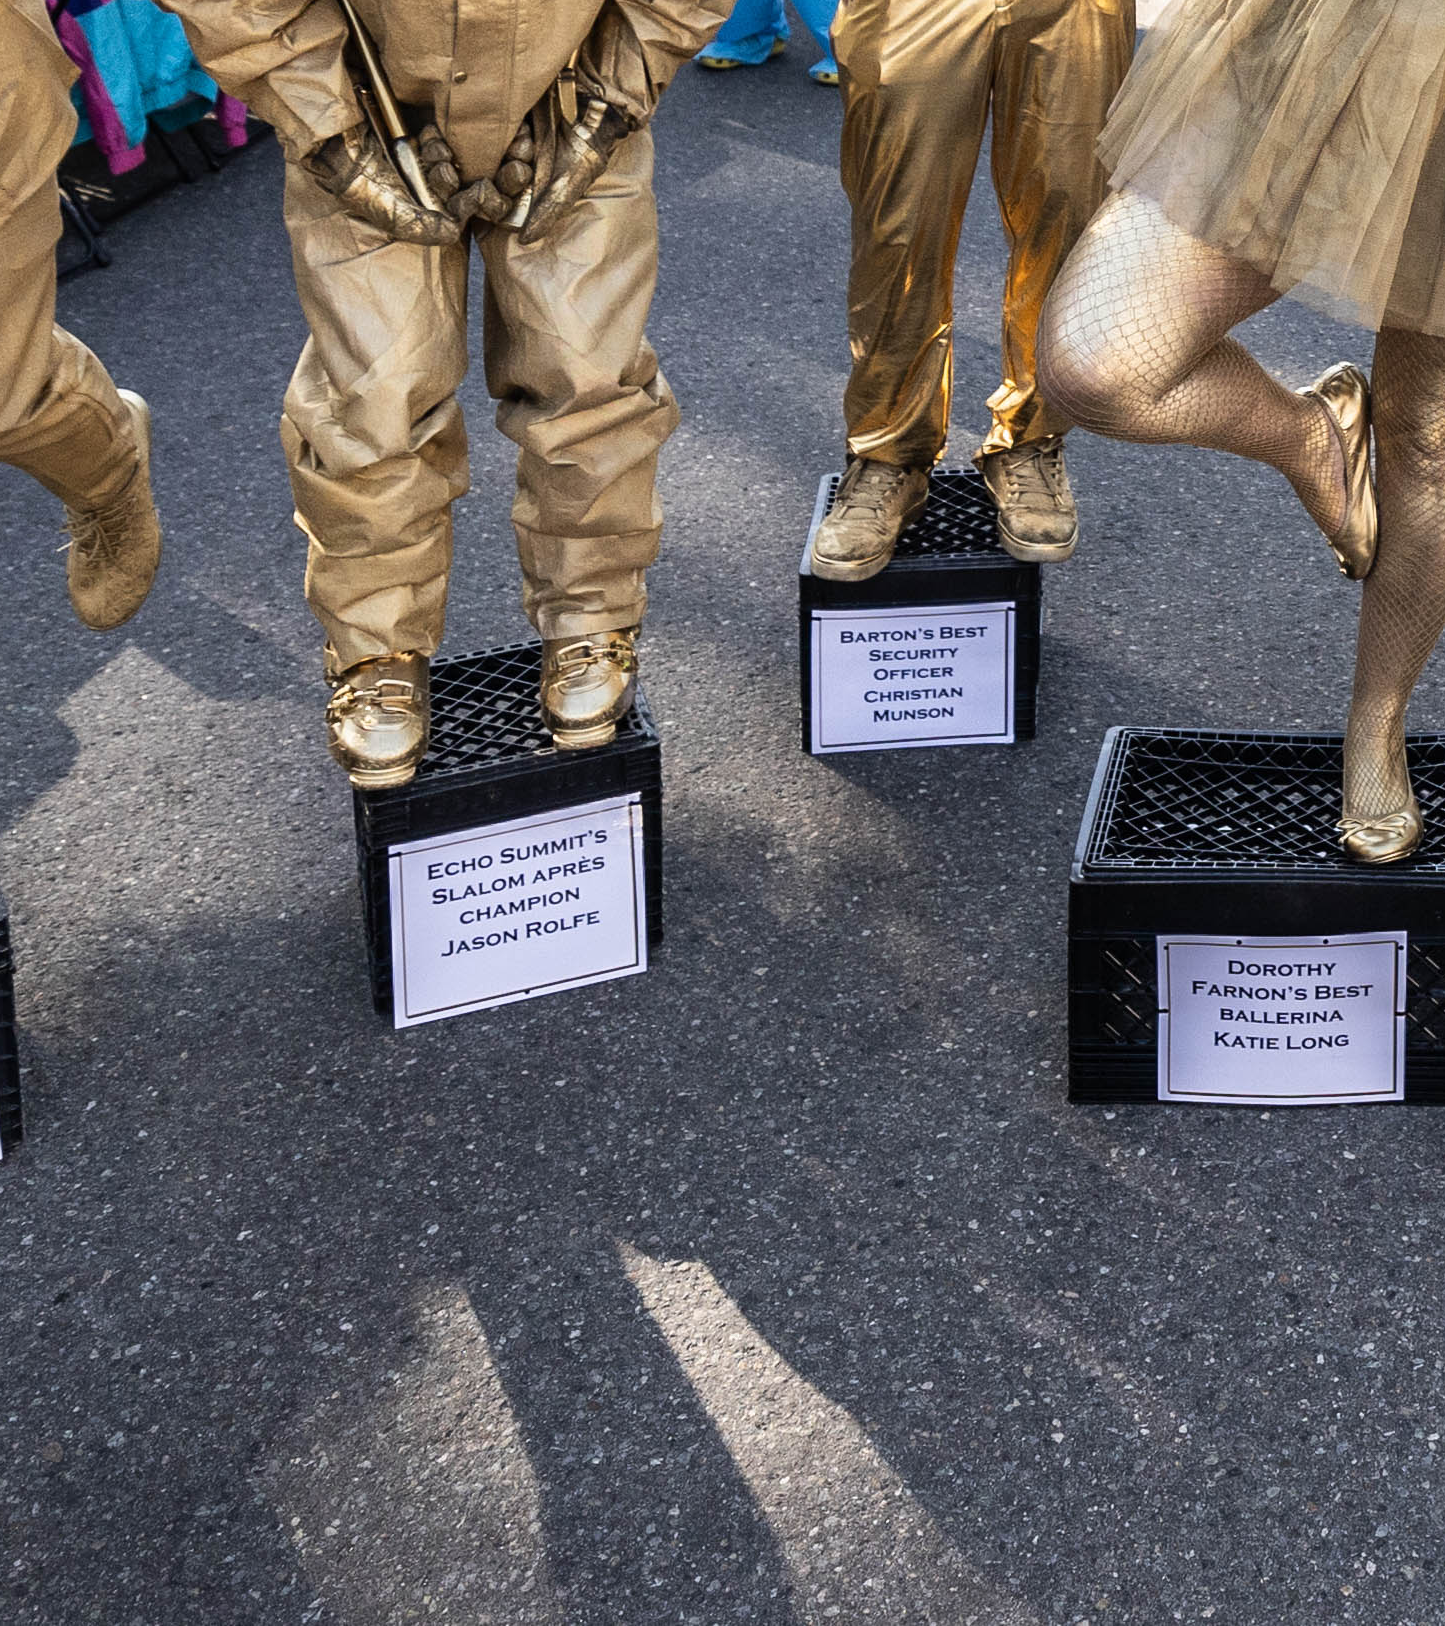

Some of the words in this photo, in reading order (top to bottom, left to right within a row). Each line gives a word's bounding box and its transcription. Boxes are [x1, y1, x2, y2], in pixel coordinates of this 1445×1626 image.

[840, 627, 935, 644] BARTON'S
[939, 626, 988, 640] BEST
[868, 647, 959, 662] SECURITY
[873, 666, 954, 681] OFFICER
[863, 686, 963, 704] CHRISTIAN
[873, 706, 954, 723] MUNSON
[427, 855, 493, 881] ECHO
[500, 829, 608, 864] SUMMIT'S
[432, 873, 525, 905] SLALOM
[459, 887, 580, 925] CHAMPION
[441, 928, 518, 957] JASON
[525, 910, 600, 939] ROLFE
[1227, 959, 1337, 977] DOROTHY
[1191, 980, 1308, 1001] FARNON'S
[1314, 984, 1374, 1000] BEST
[1219, 1007, 1344, 1025] BALLERINA
[1214, 1031, 1280, 1050] KATIE
[1286, 1034, 1350, 1050] LONG
